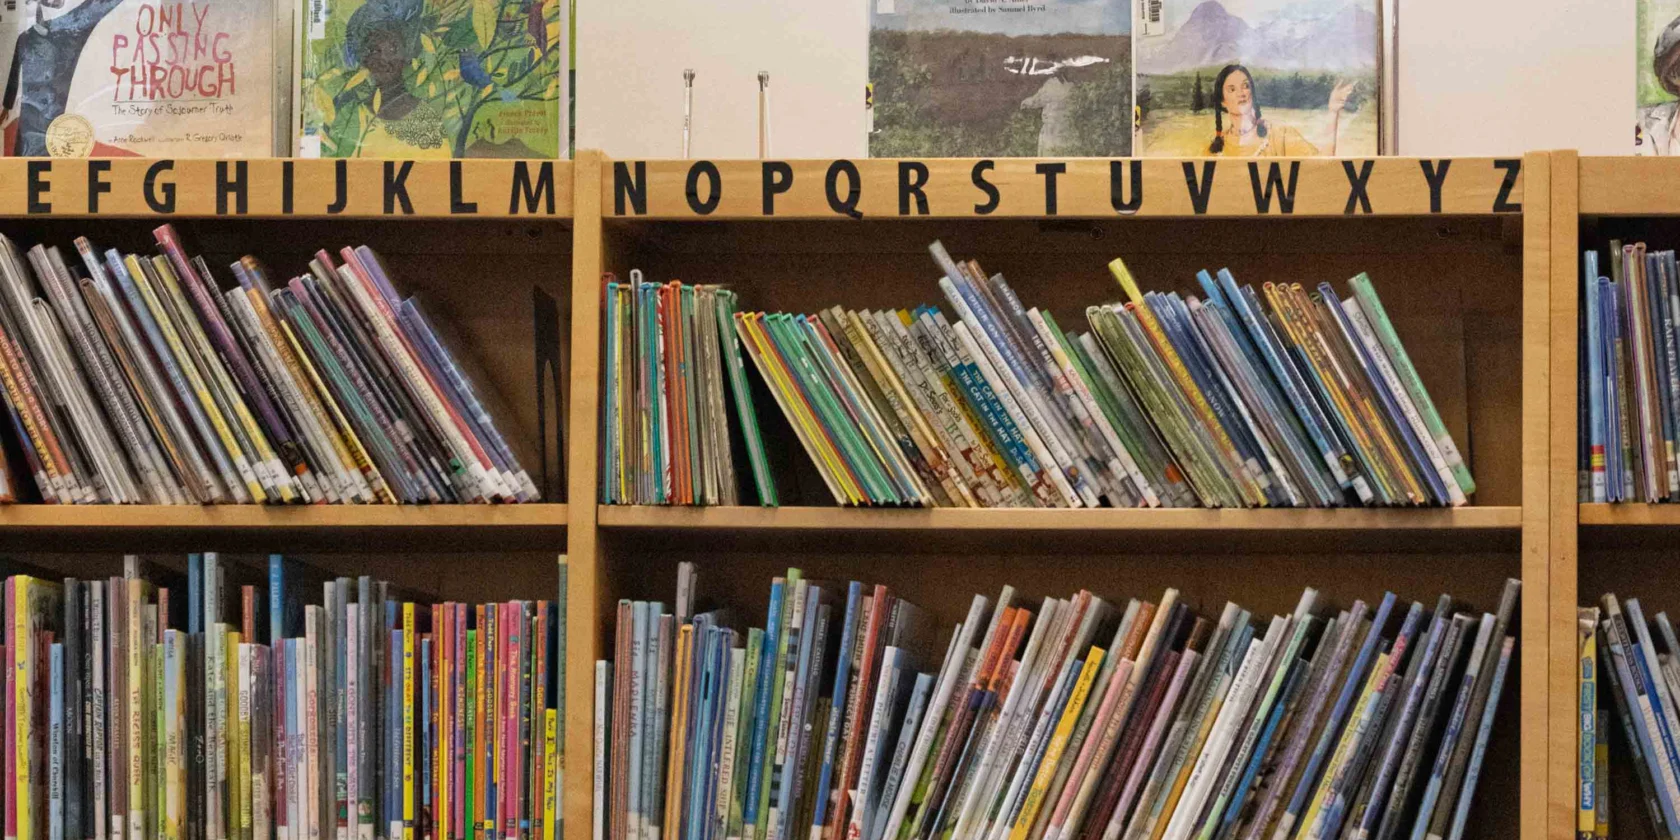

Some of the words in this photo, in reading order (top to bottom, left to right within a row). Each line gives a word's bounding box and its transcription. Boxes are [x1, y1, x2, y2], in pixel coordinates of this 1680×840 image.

[136, 3, 208, 37] ONLY
[949, 6, 986, 14] illustrated
[988, 6, 996, 14] by
[1027, 5, 1046, 13] Byrd
[112, 32, 233, 67] PASSING
[110, 62, 236, 101] THROUGH
[112, 104, 126, 116] The
[128, 104, 152, 117] Story
[154, 105, 163, 114] of
[165, 103, 207, 116] Sojourner
[210, 102, 233, 114] Truth
[28, 161, 51, 213] E
[88, 161, 111, 213] F
[143, 160, 176, 214] G
[216, 161, 248, 214] H
[282, 161, 293, 214] I
[327, 160, 347, 214] J
[383, 161, 414, 214] K
[450, 161, 477, 214] L
[509, 161, 555, 214] M
[614, 161, 647, 215] N
[685, 160, 721, 215] O
[762, 161, 793, 215] P
[825, 159, 863, 220] Q
[898, 161, 930, 215] R
[971, 160, 1000, 215] S
[1036, 163, 1066, 215] T
[1110, 160, 1142, 214] U
[1182, 161, 1216, 214] V
[1247, 161, 1300, 214] W
[1341, 160, 1374, 214] X
[1419, 159, 1451, 213] Y
[1492, 159, 1522, 213] Z
[998, 281, 1024, 316] SHANNON
[968, 294, 988, 321] DUCK
[986, 322, 999, 338] ON
[998, 340, 1006, 348] A
[1664, 318, 1674, 346] RAIN
[1030, 333, 1044, 349] THE
[0, 336, 13, 357] HOW
[9, 358, 19, 370] TO
[15, 371, 31, 394] READ
[31, 404, 49, 432] STORY
[83, 321, 104, 352] MOSES
[99, 352, 116, 377] GOES
[111, 377, 122, 390] TO
[117, 390, 140, 425] SCHOOL
[1666, 350, 1678, 391] PLAYER
[959, 371, 972, 385] THE
[969, 386, 982, 402] CAT
[979, 402, 989, 412] IN
[987, 413, 998, 427] THE
[996, 427, 1010, 444] HAT
[972, 370, 984, 384] THE
[981, 384, 995, 400] CAT
[992, 401, 1002, 411] IN
[1000, 412, 1012, 426] THE
[1204, 388, 1225, 418] SNOW
[271, 582, 279, 608] PALACIO
[860, 609, 870, 632] LANE
[510, 650, 518, 665] The
[812, 646, 822, 676] CASTILLO
[855, 634, 866, 660] SMITH
[1615, 619, 1635, 665] EYEWITNESS
[1629, 666, 1642, 690] BOOKS
[204, 656, 214, 682] Kate
[509, 667, 517, 698] Mommy
[131, 687, 139, 704] THE
[205, 689, 214, 706] and
[508, 700, 516, 719] Book
[627, 670, 640, 738] MADLENKA
[844, 683, 856, 719] PERFECT
[65, 706, 74, 734] MOON
[131, 711, 140, 748] RECESS
[206, 712, 215, 730] the
[726, 708, 735, 726] THE
[827, 706, 839, 733] Jingle
[841, 721, 851, 741] DAY
[869, 701, 883, 743] PICTURE
[1250, 717, 1262, 731] THE
[1582, 712, 1594, 731] BIG
[50, 722, 59, 754] Winston
[822, 735, 834, 764] Dancer
[1239, 730, 1255, 754] GREAT
[1582, 733, 1594, 764] BOOK
[51, 757, 59, 765] of
[132, 755, 140, 786] QUEEN
[206, 736, 217, 793] Beanstalk
[889, 741, 907, 776] CHARLIE
[1231, 752, 1244, 771] FUZZ
[1582, 764, 1594, 781] OF
[51, 766, 60, 800] Churchill
[859, 757, 873, 795] LETTER
[1218, 770, 1236, 797] FRENZY
[717, 788, 727, 810] SHIP
[880, 782, 895, 810] MOUSE
[1582, 783, 1594, 807] WHY
